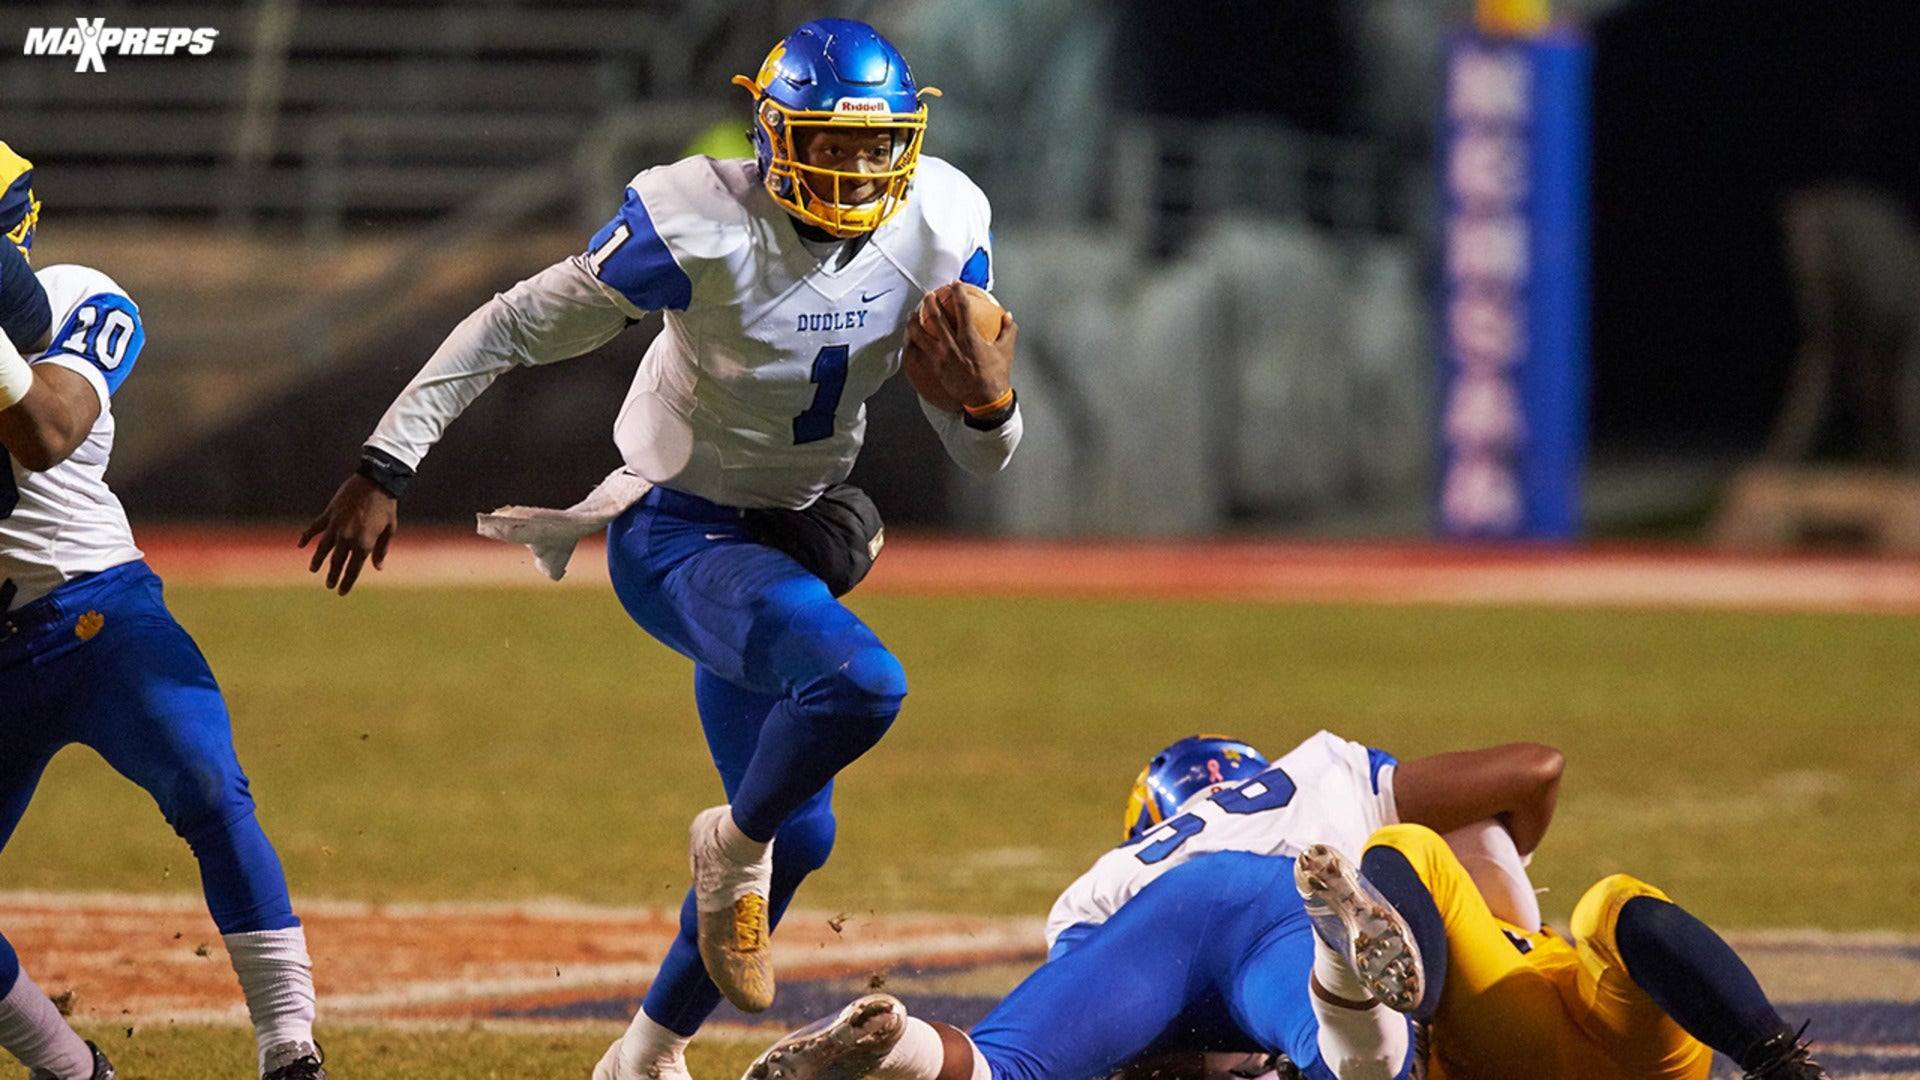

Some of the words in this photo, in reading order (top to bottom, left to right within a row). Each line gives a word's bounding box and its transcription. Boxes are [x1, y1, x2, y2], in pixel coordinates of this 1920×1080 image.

[842, 101, 884, 112] Riddell
[588, 220, 633, 277] 1
[62, 305, 135, 371] 10
[797, 310, 868, 332] DUDLEY
[793, 344, 849, 445] 1
